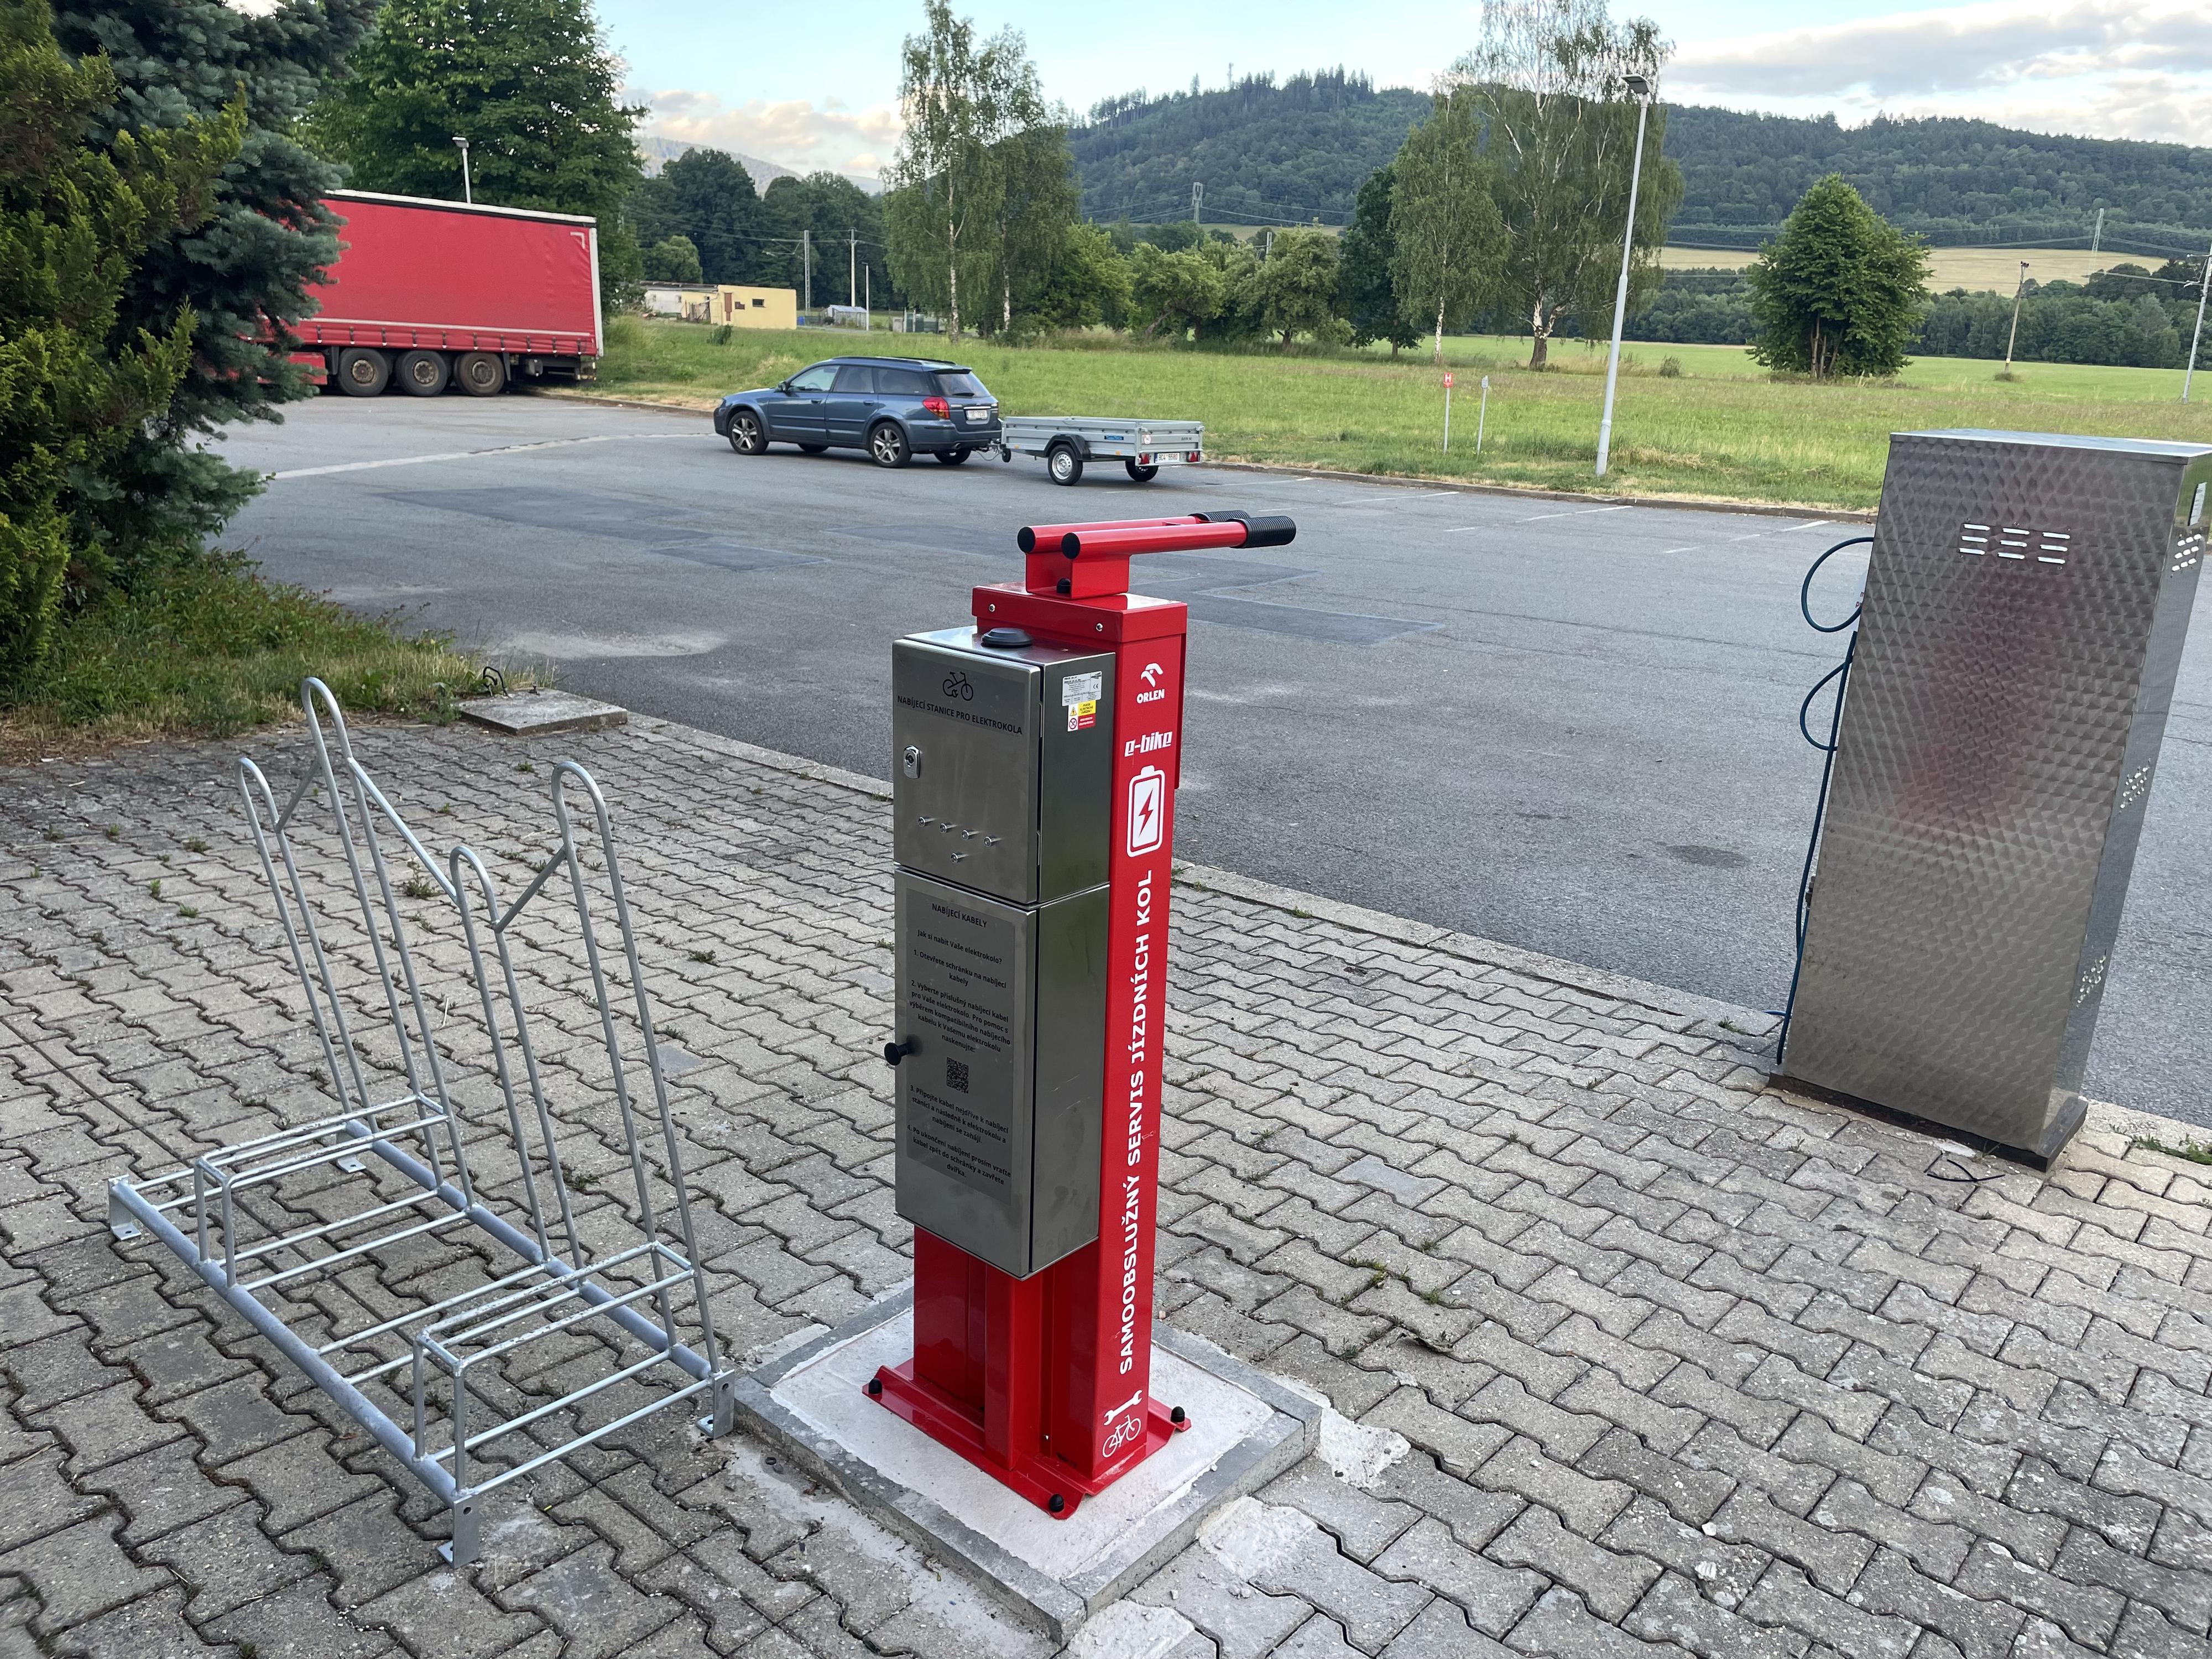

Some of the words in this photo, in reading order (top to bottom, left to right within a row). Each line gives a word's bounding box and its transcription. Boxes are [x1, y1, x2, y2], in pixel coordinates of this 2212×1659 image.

[898, 696, 925, 709] NABÍJECÍ
[927, 703, 954, 717] STANICE
[956, 711, 970, 721] PRO
[972, 716, 1022, 734] ELEKTROKOLA
[1136, 688, 1165, 704] ORLEN
[1124, 731, 1173, 757] e-bike
[932, 903, 960, 919] NABÍJECÍ
[962, 913, 987, 928] KABELY
[1137, 869, 1152, 926] KOL
[934, 936, 948, 946] nabít
[950, 941, 963, 951] Vaše
[965, 947, 1002, 964] elektrokolo?
[920, 952, 945, 966] Otevřete
[946, 961, 972, 976] schránku
[983, 976, 1006, 988] nabíjecí
[950, 973, 968, 987] kabely
[917, 982, 939, 995] Vyberte
[941, 992, 967, 1007] příslušný
[968, 1001, 991, 1015] nabíjecí
[992, 1010, 1008, 1022] kabel
[922, 994, 935, 1005] Vaše
[936, 1000, 971, 1019] elektrokolo.
[972, 1014, 982, 1022] Pro
[984, 1020, 1004, 1032] pomoc
[1128, 933, 1149, 1064] JÍZDNÍCH
[910, 1001, 933, 1014] výběrem
[935, 1010, 978, 1032] kompatibilního
[980, 1029, 1011, 1045] nabíjecího
[918, 1014, 936, 1026] kabelu
[943, 1024, 966, 1038] Vašemu
[967, 1034, 1001, 1052] elektrokolu
[942, 1034, 975, 1052] naskenujte:
[912, 1097, 930, 1109] stanici
[936, 1108, 961, 1123] následně
[968, 1121, 1000, 1141] elektrokolu
[916, 1088, 938, 1102] Připojte
[939, 1097, 954, 1110] kabel
[956, 1107, 979, 1120] nejdříve
[985, 1119, 1009, 1134] nabíjecí
[1128, 1069, 1144, 1167] SERVIS
[913, 1137, 928, 1149] kabel
[929, 1145, 941, 1155] zpět
[951, 1155, 976, 1172] schránky
[982, 1170, 1004, 1185] zavřete
[921, 1131, 946, 1147] ukončení
[972, 1155, 991, 1168] prosím
[1120, 1175, 1140, 1375] SAMOOBSLUŽNÝ
